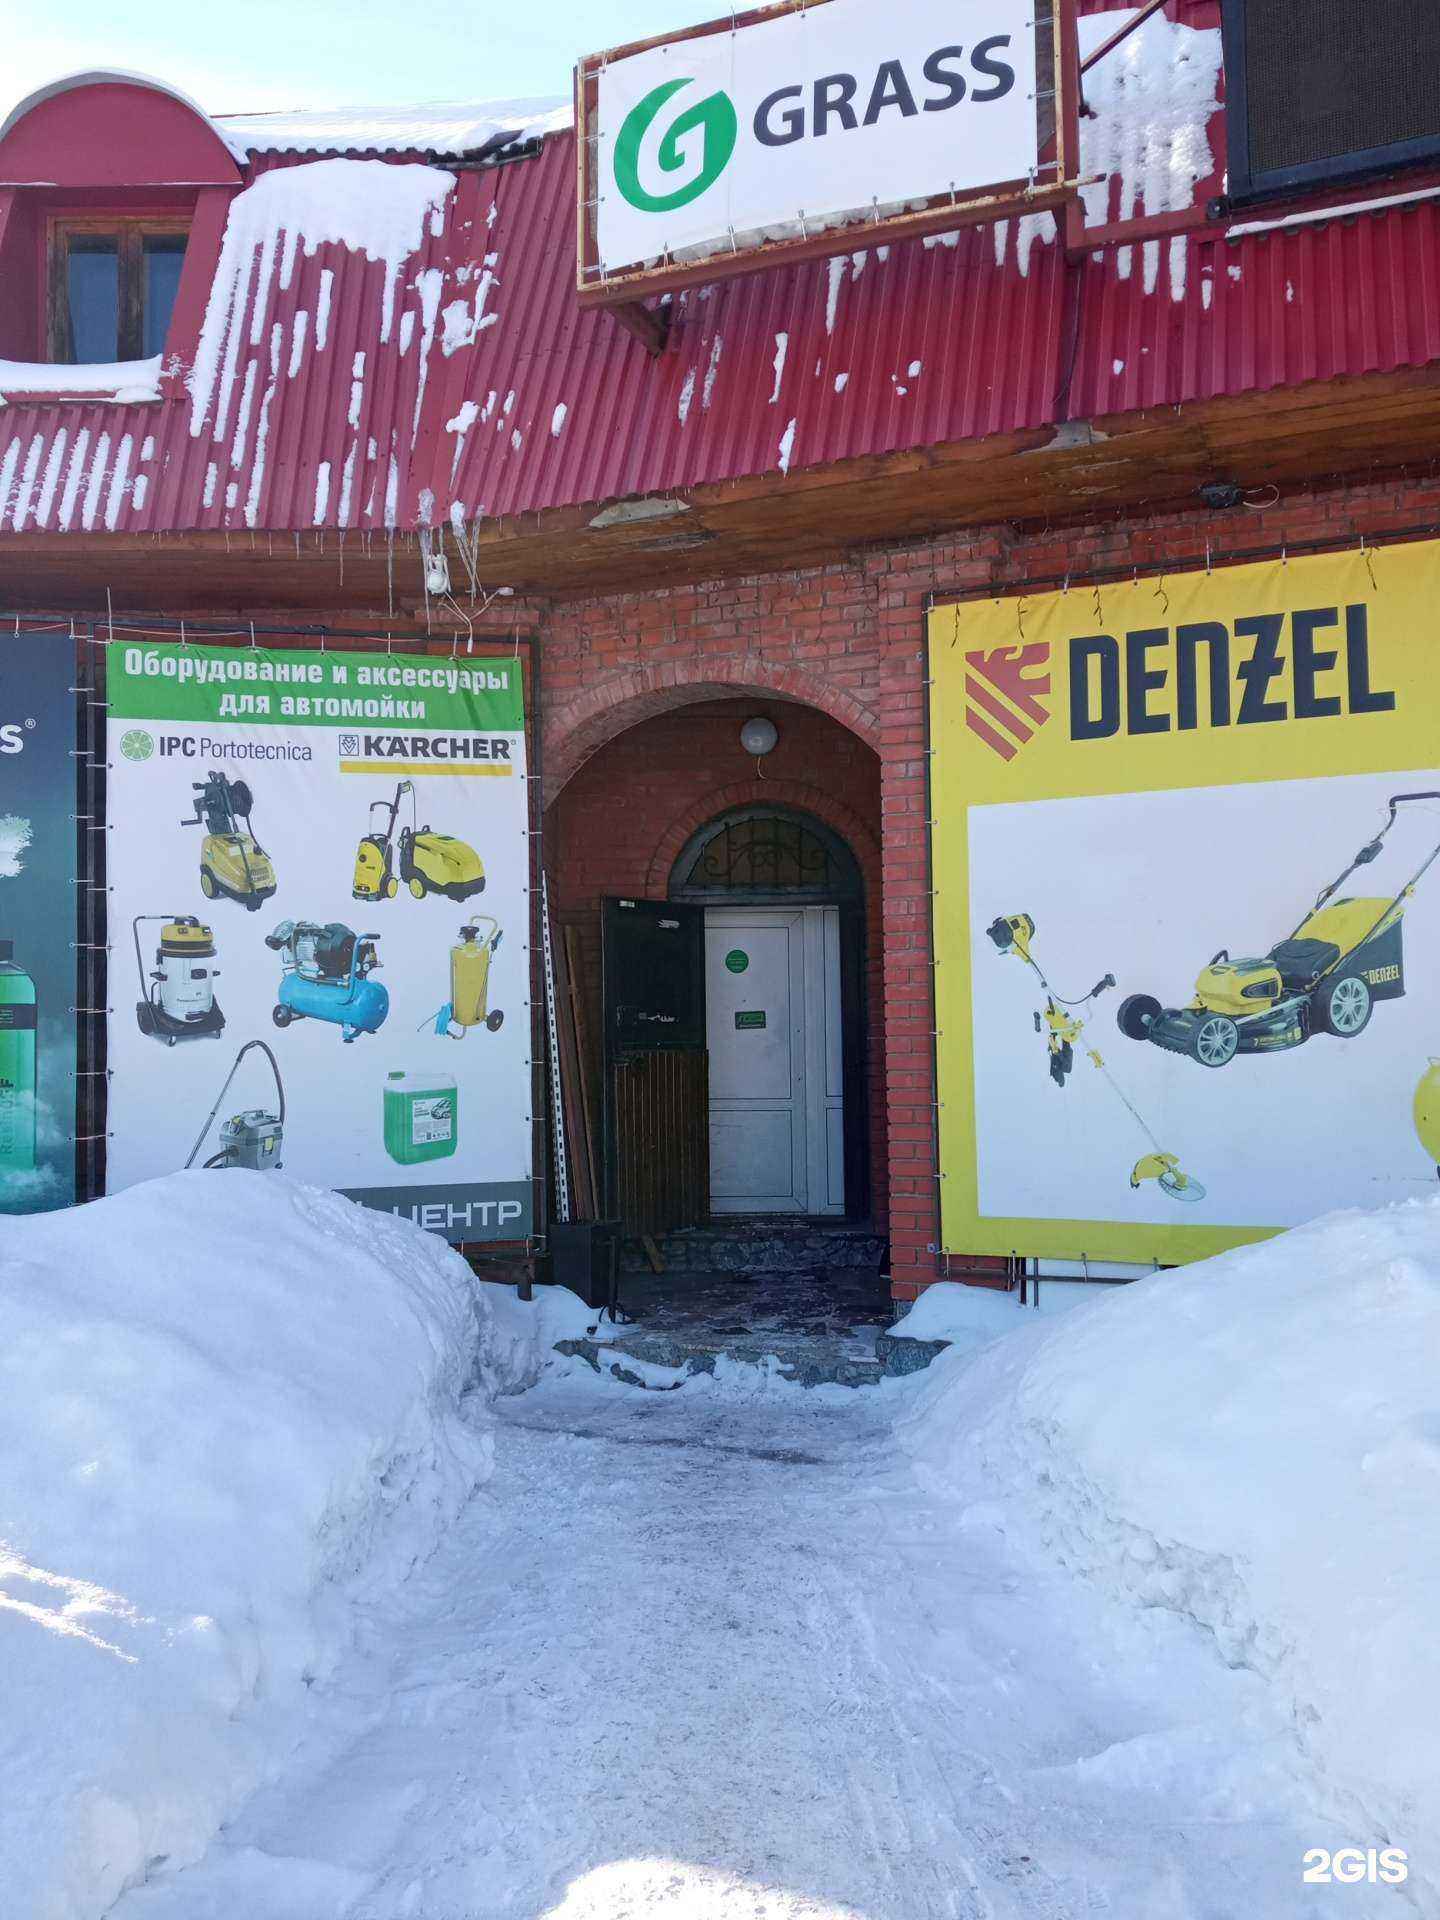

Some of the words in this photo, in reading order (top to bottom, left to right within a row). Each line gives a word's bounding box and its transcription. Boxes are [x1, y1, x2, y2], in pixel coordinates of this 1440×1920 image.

[752, 34, 1016, 148] GRASS
[124, 648, 323, 684] Оборудование
[332, 665, 348, 684] и
[357, 666, 510, 696] аксессуары
[1068, 602, 1396, 742] DENZEL
[219, 693, 271, 717] для
[280, 693, 426, 720] автомойки
[159, 735, 196, 758] IPC
[200, 736, 313, 761] Portotecnica
[364, 735, 512, 760] KÄRCHER
